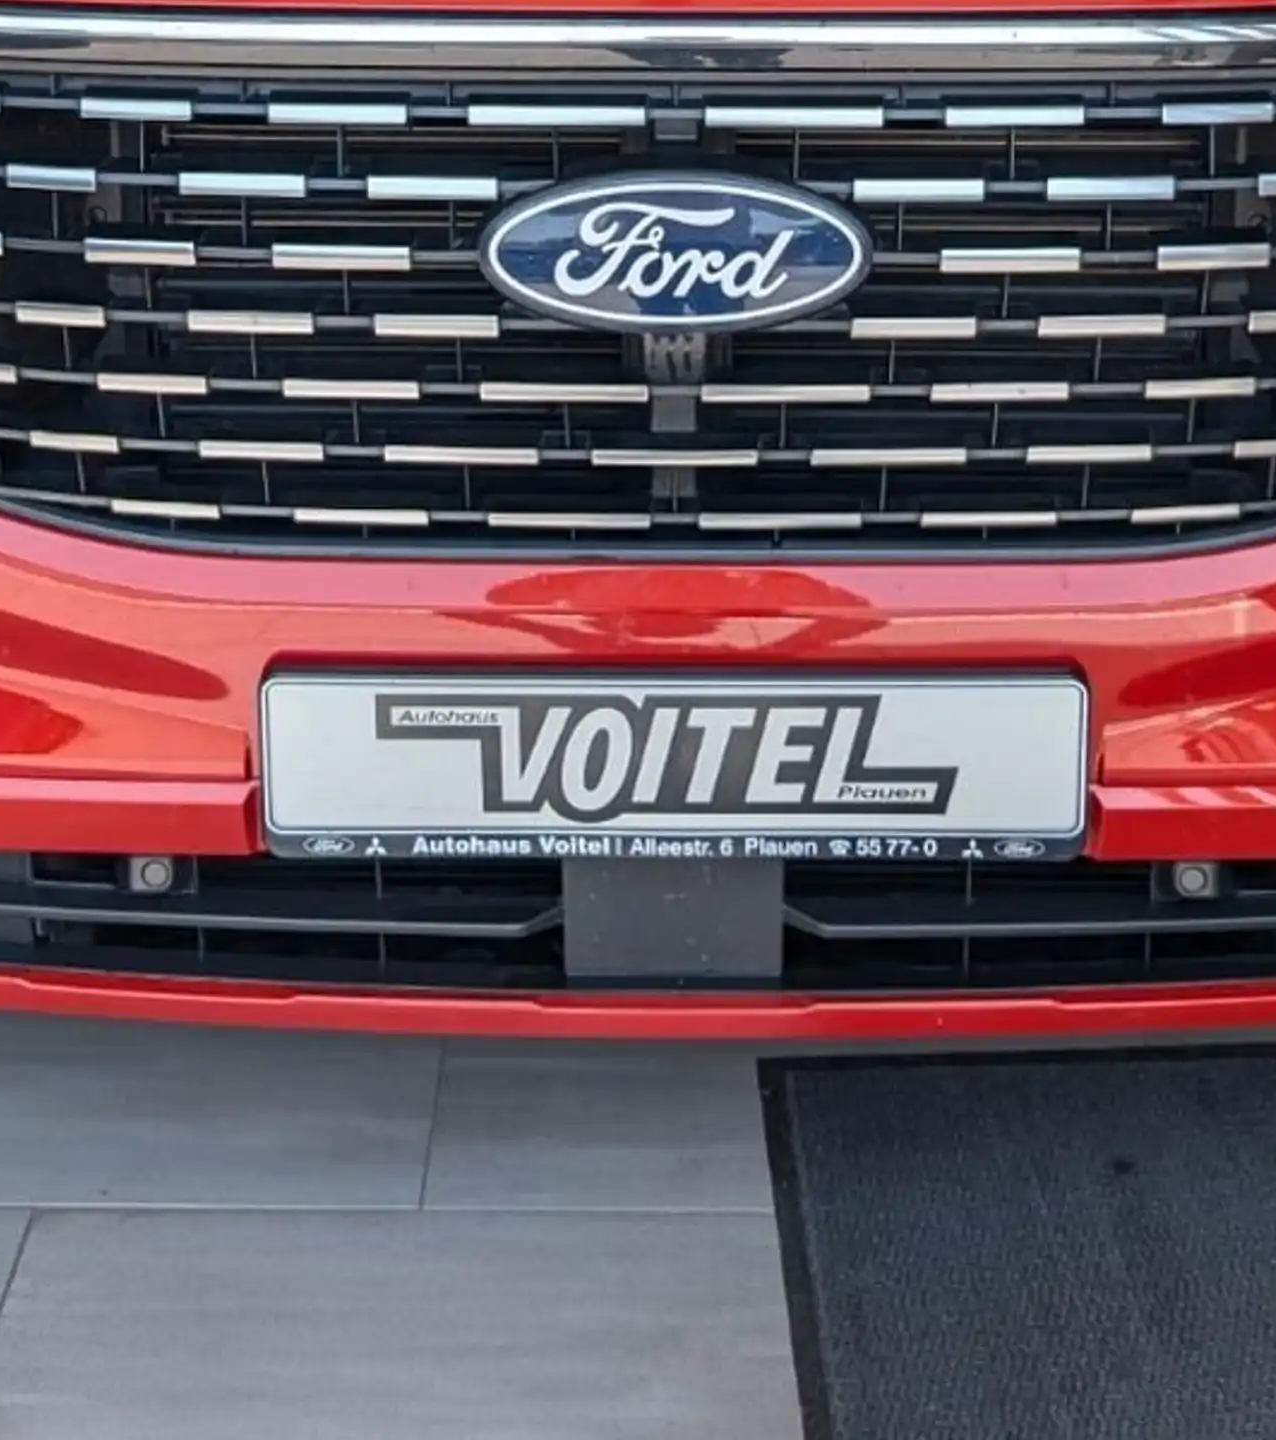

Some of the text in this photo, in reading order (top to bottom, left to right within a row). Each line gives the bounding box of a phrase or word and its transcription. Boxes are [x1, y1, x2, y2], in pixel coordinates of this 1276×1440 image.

[554, 201, 795, 299] Ford
[397, 708, 500, 725] Autohaus
[498, 705, 866, 811] VOITEL
[836, 783, 928, 800] Plauen
[411, 835, 531, 855] Autohaus
[538, 835, 611, 855] Voitel
[629, 837, 714, 857] Alleestr.
[719, 838, 734, 857] 6
[744, 837, 819, 857] Plauen
